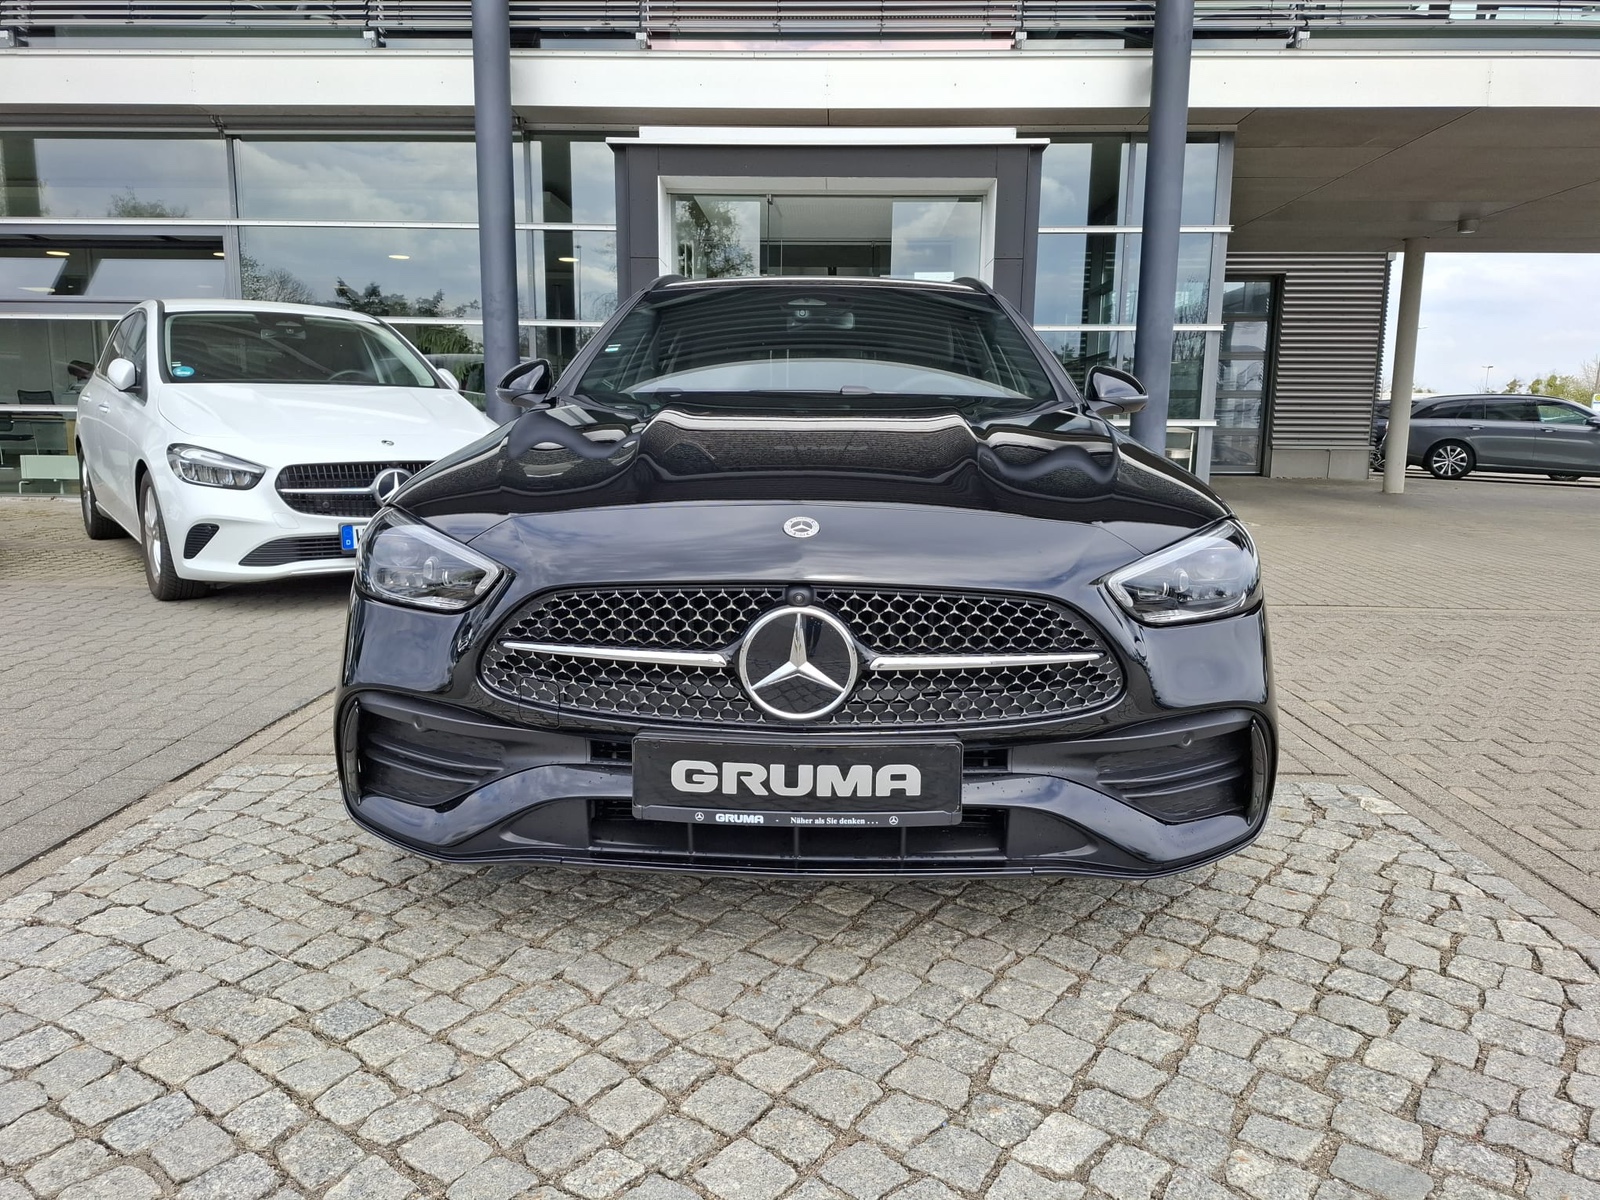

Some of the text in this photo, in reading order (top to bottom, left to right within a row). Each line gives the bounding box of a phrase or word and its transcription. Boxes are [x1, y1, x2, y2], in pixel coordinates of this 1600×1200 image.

[670, 759, 922, 797] GRUMA
[715, 813, 764, 824] GRUMA
[790, 816, 813, 824] Näher
[814, 816, 825, 824] als
[826, 817, 837, 825] Sie
[839, 816, 866, 825] denken
